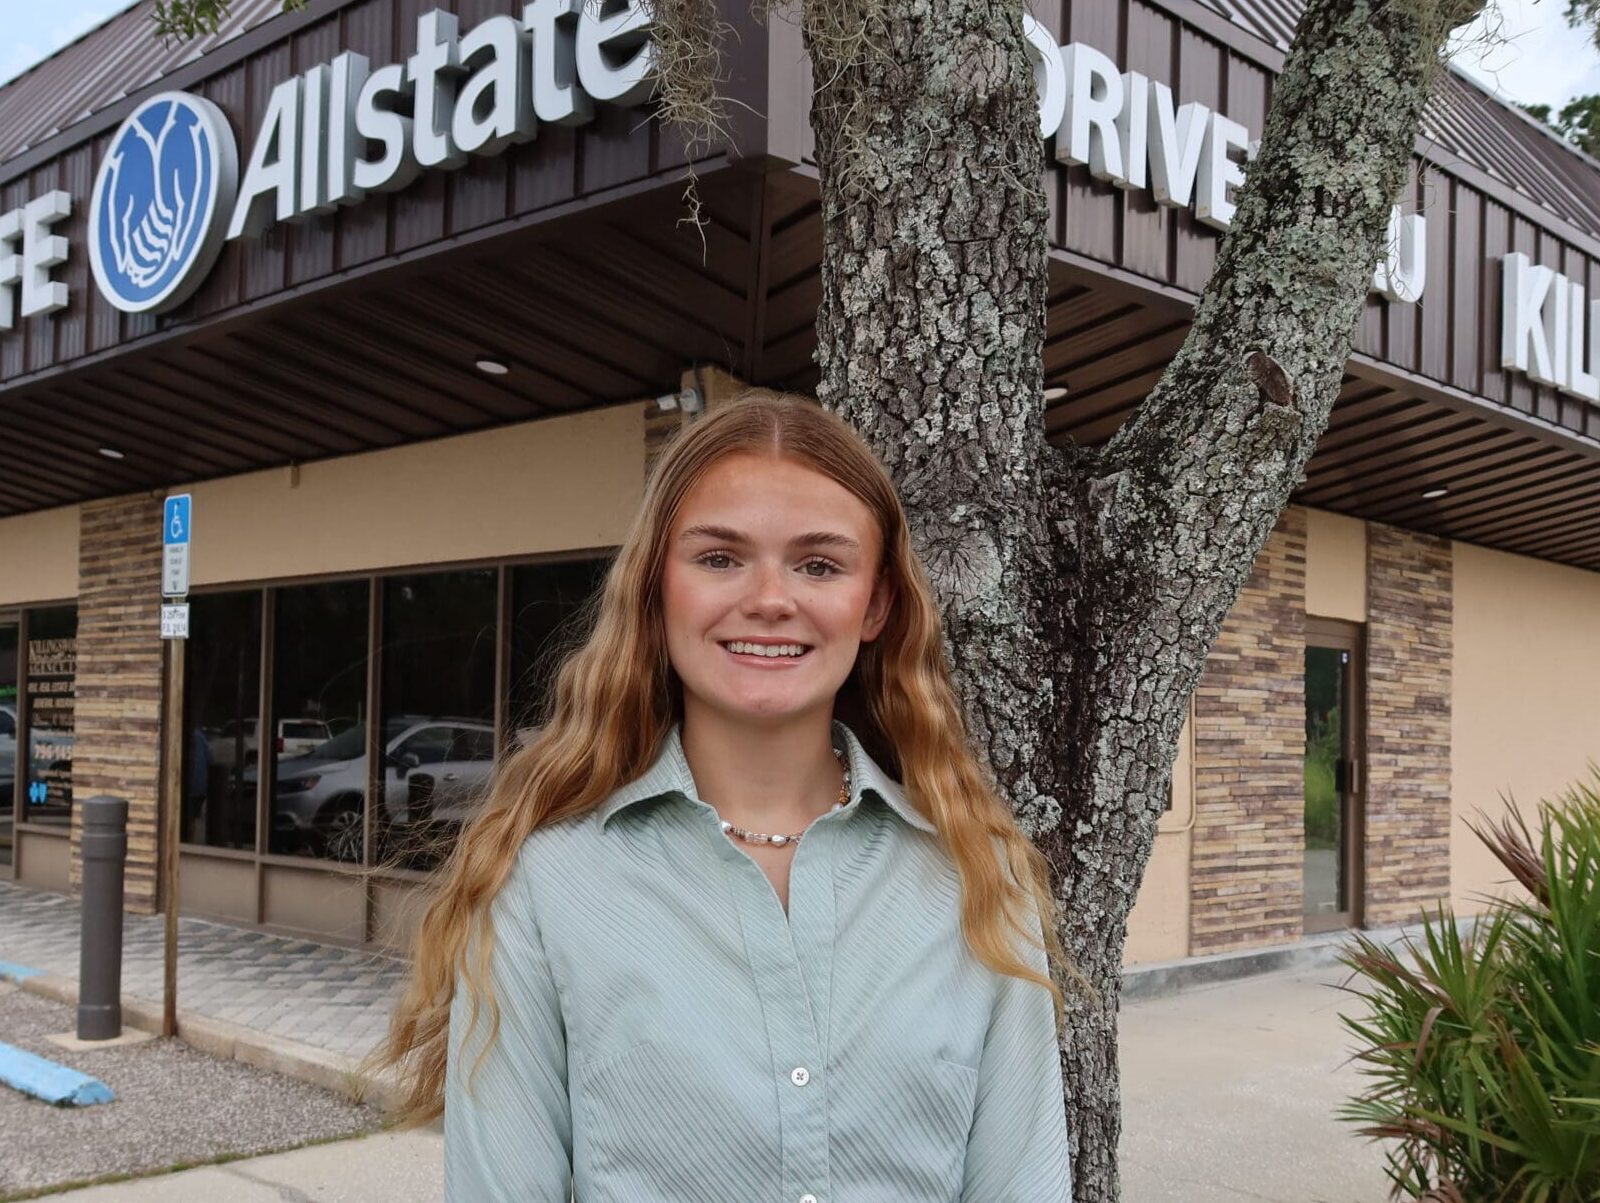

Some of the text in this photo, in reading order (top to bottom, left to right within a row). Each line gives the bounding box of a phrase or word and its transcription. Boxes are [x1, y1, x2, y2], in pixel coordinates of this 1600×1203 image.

[227, 0, 656, 240] Allstate
[1022, 12, 1262, 232] DRIVE
[1501, 251, 1600, 404] KIL
